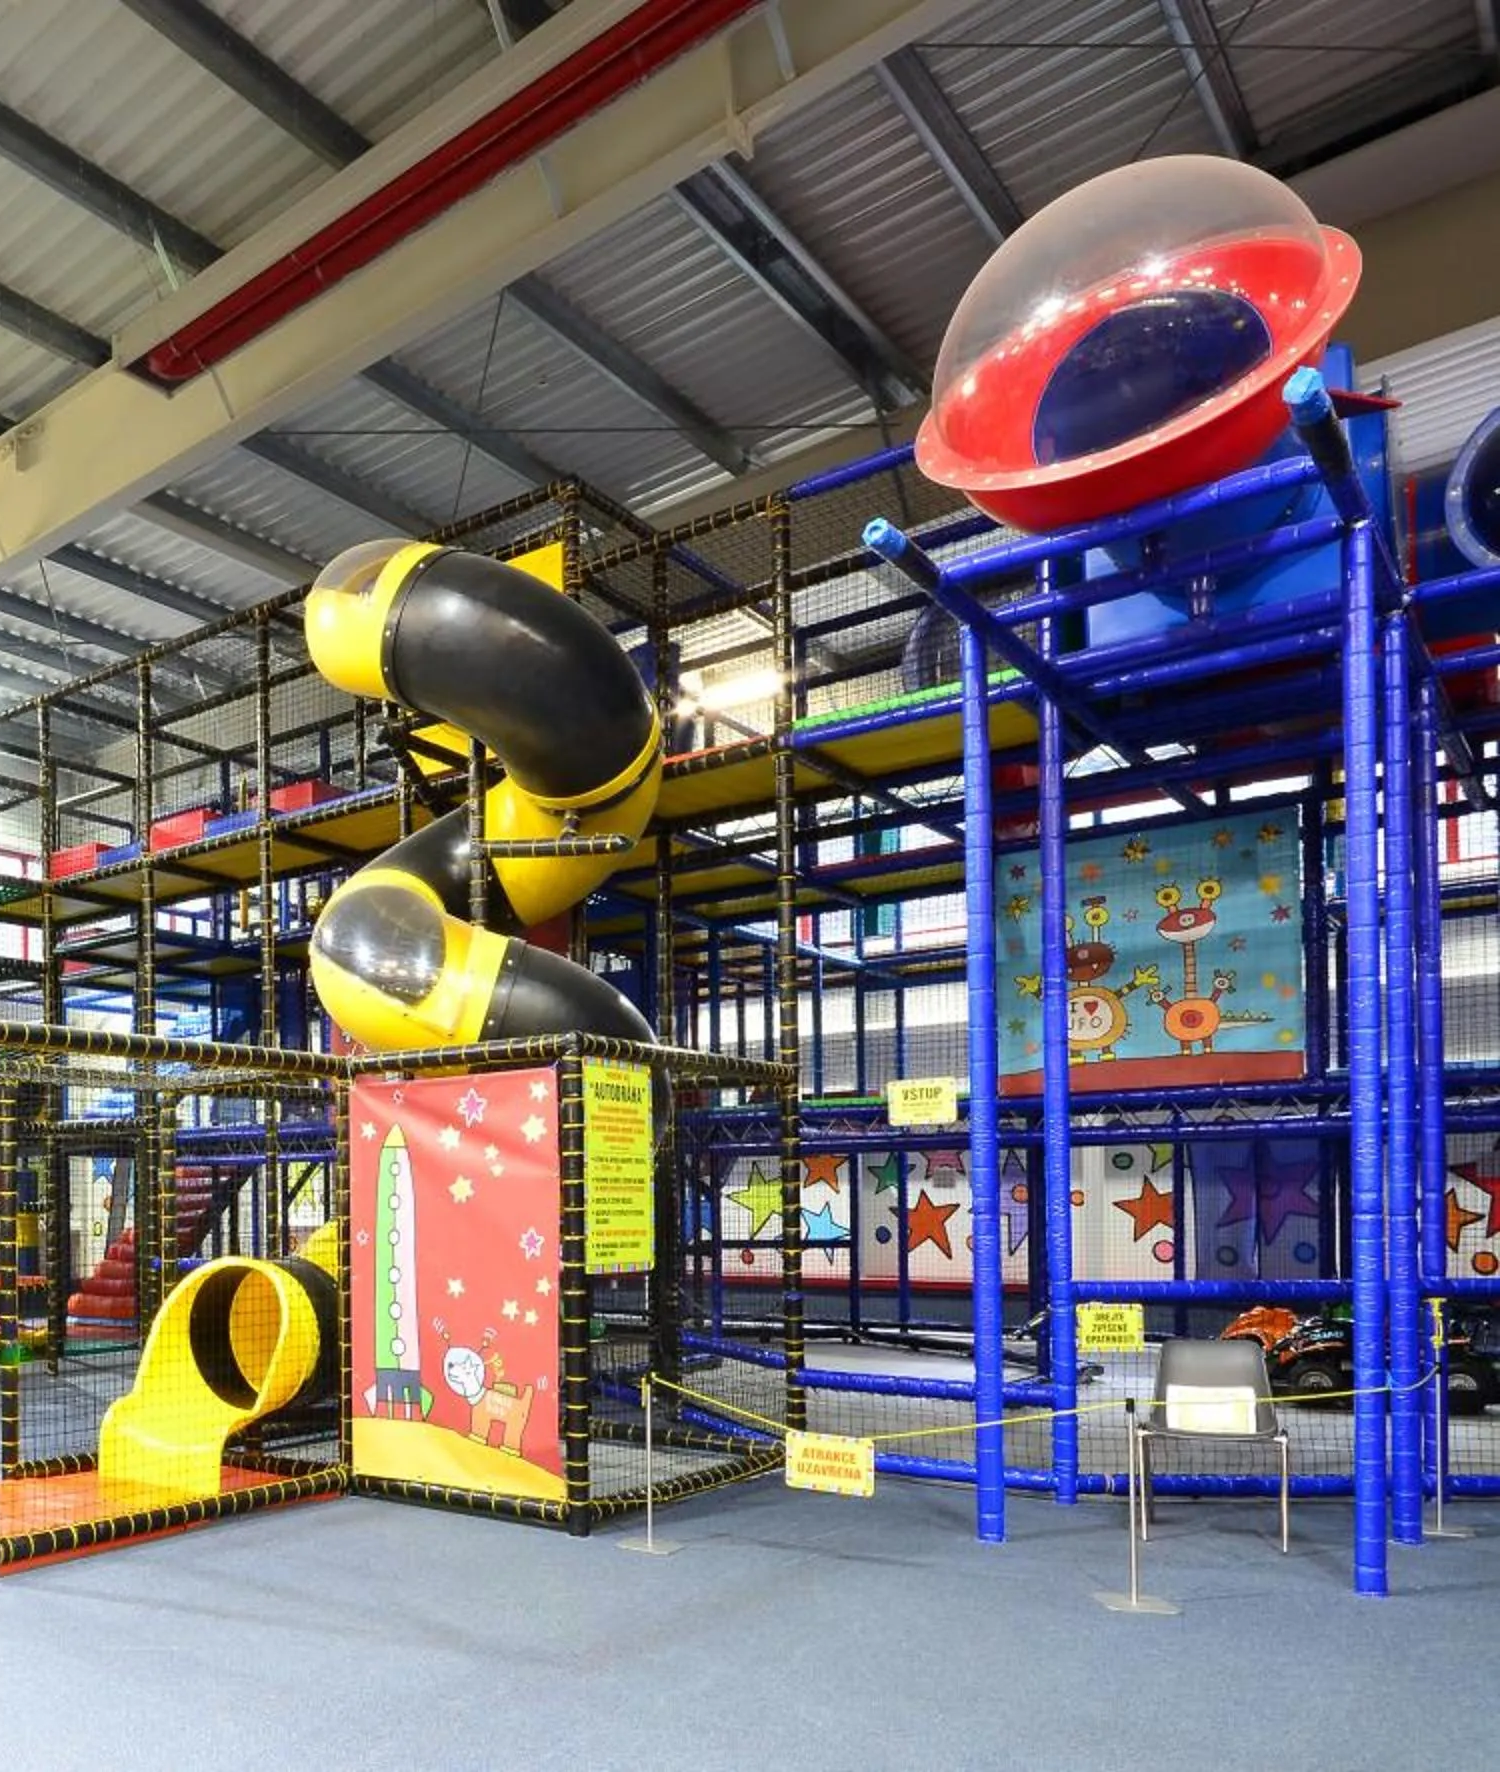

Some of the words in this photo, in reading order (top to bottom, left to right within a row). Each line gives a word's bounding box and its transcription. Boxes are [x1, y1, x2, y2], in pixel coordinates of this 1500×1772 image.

[1070, 1001, 1078, 1013] I
[901, 1086, 943, 1101] VSTUP
[801, 1447, 858, 1465] ATRAKCE
